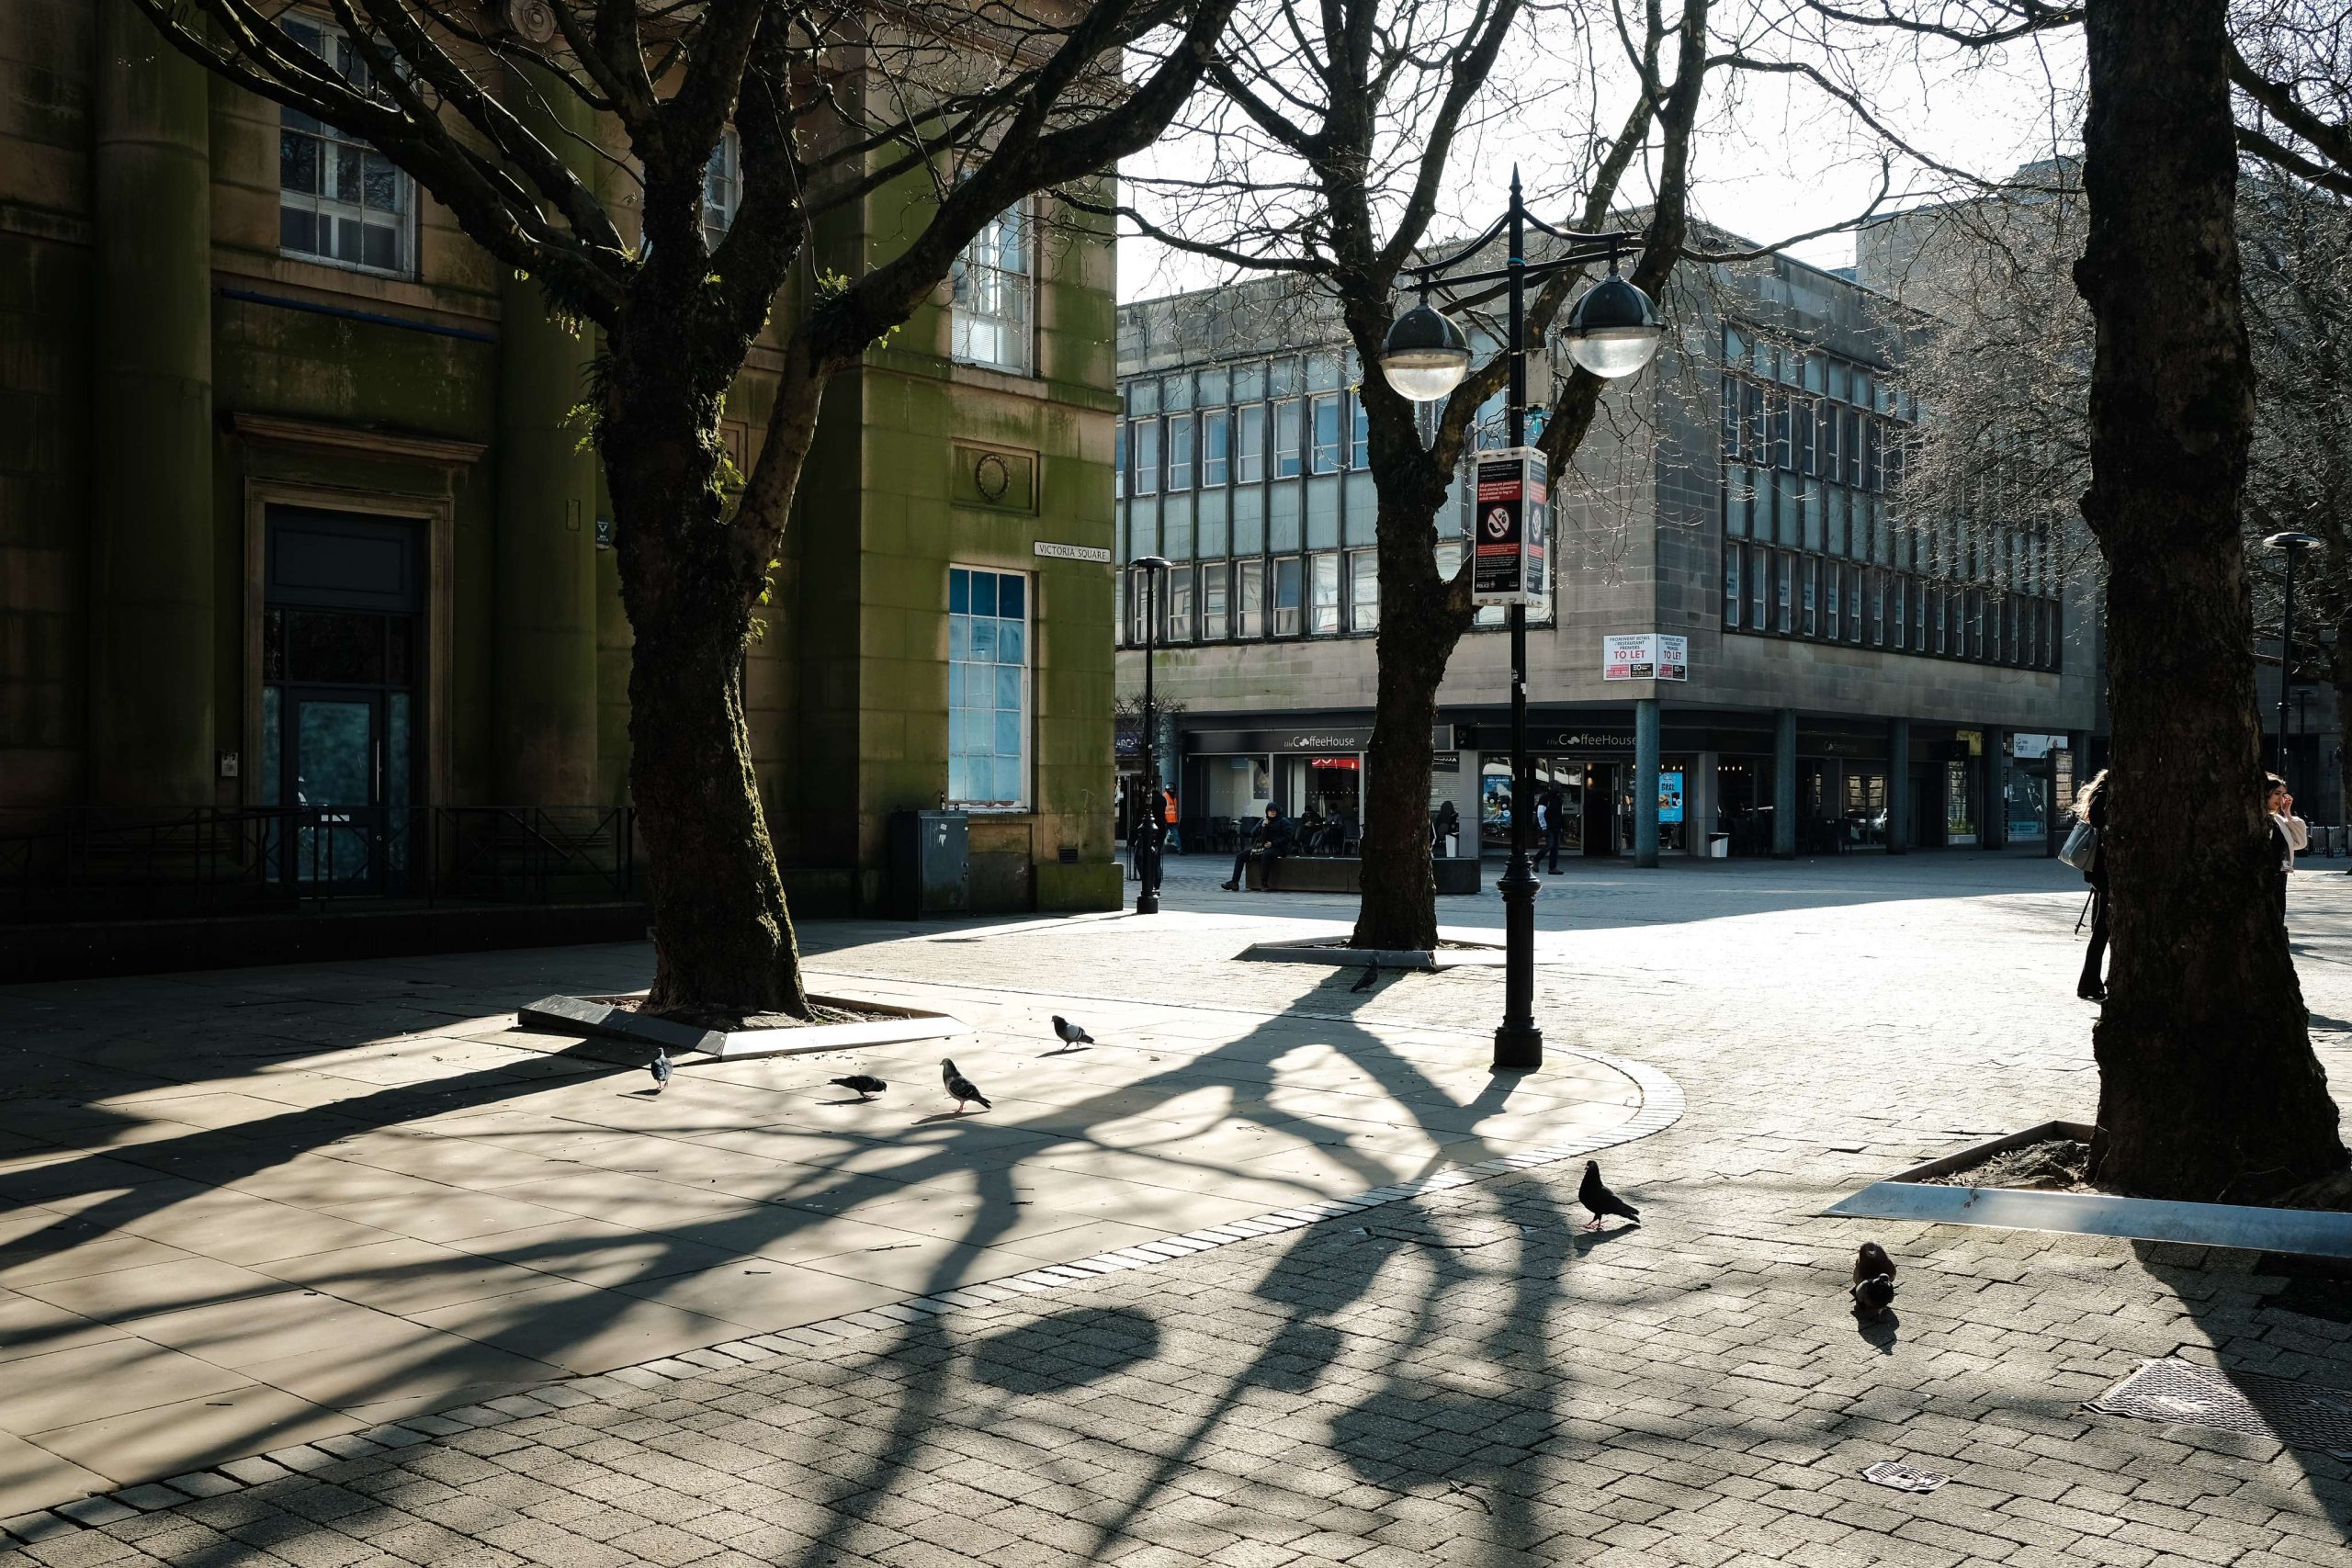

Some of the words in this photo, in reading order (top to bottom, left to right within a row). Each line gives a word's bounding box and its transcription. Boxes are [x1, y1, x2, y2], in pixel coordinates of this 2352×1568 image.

[1039, 545, 1075, 557] VICTORIA
[1078, 549, 1106, 559] SQUARE
[1614, 650, 1626, 660] TO
[1631, 650, 1645, 659] LET
[1664, 650, 1671, 659] TO
[1673, 651, 1681, 660] LET
